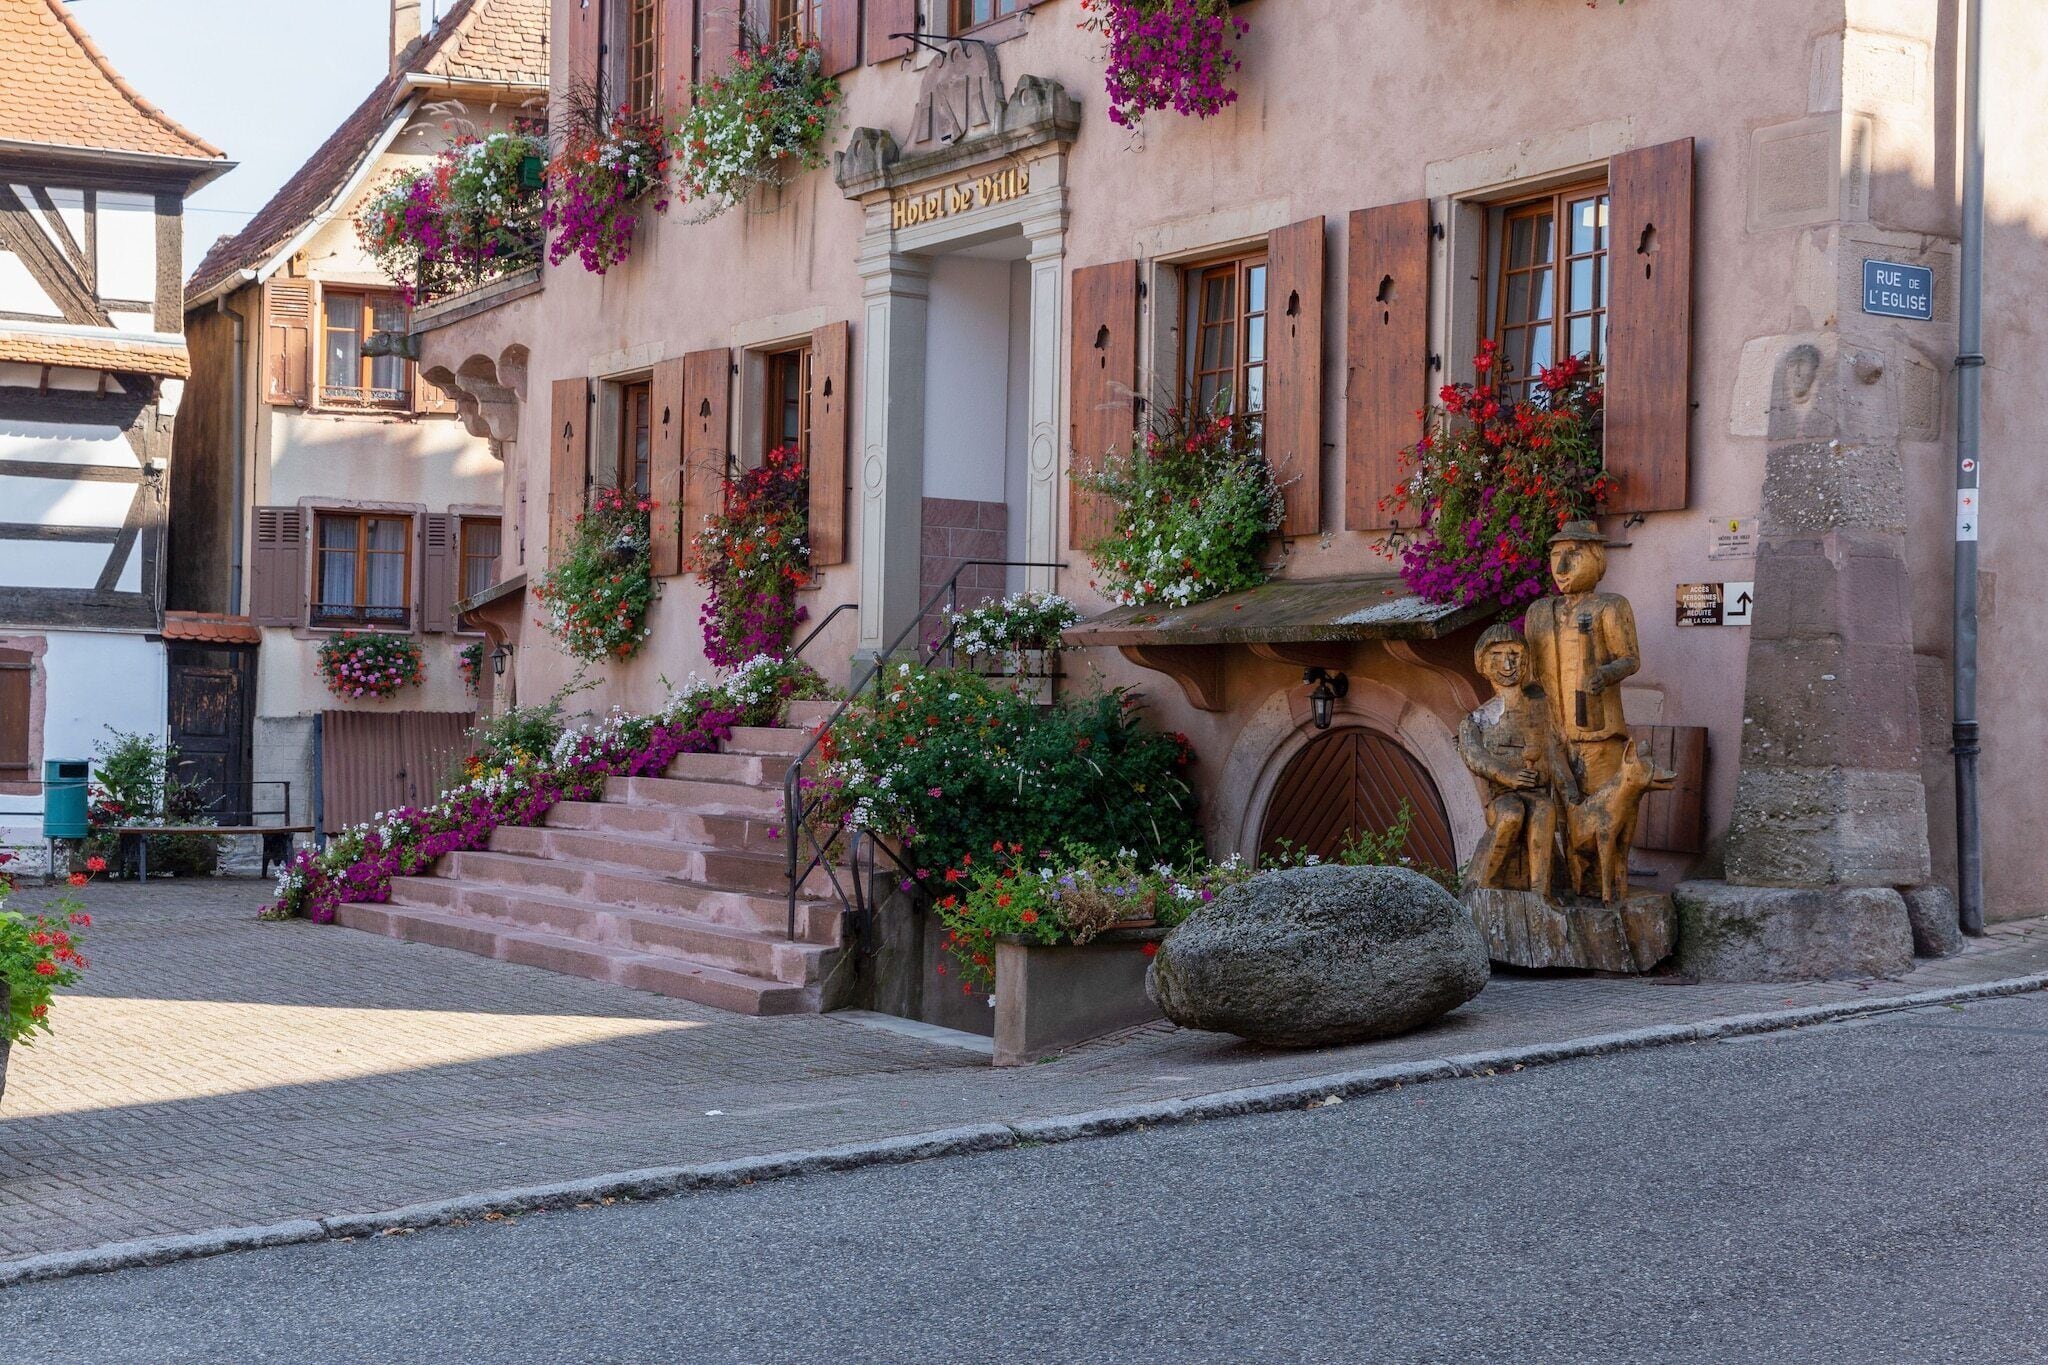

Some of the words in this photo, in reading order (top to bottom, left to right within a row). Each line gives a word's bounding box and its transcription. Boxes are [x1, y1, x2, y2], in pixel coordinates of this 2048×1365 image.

[893, 188, 945, 230] Hotel
[950, 183, 974, 214] de
[976, 167, 1030, 207] Ville
[1876, 269, 1902, 287] RUE
[1908, 278, 1920, 289] DE
